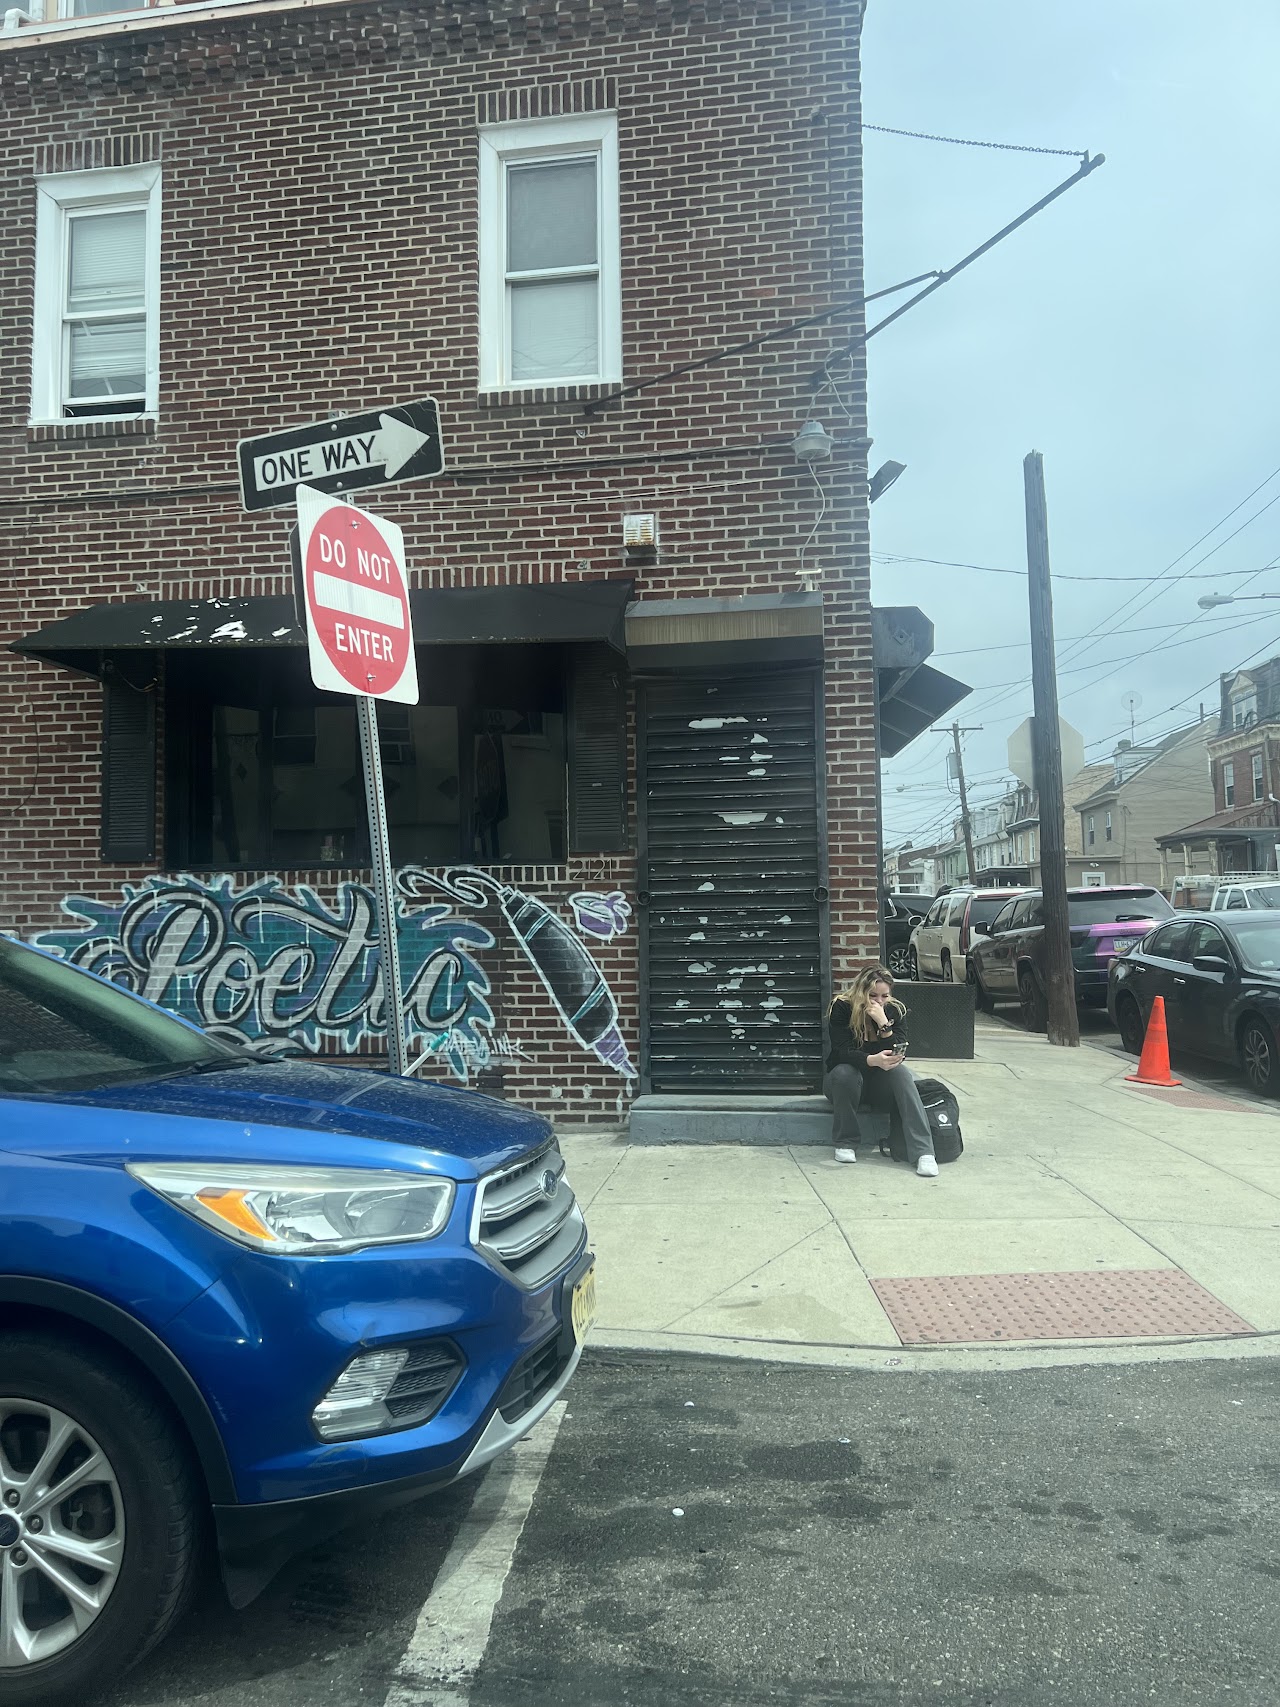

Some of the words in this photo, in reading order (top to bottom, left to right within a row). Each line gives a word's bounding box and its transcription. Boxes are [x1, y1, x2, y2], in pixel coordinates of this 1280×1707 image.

[262, 449, 314, 485] ONE
[322, 435, 376, 472] WAY
[319, 533, 347, 568] DO
[358, 547, 391, 584] NOT
[335, 622, 395, 663] ENTER
[572, 858, 613, 880] 2121
